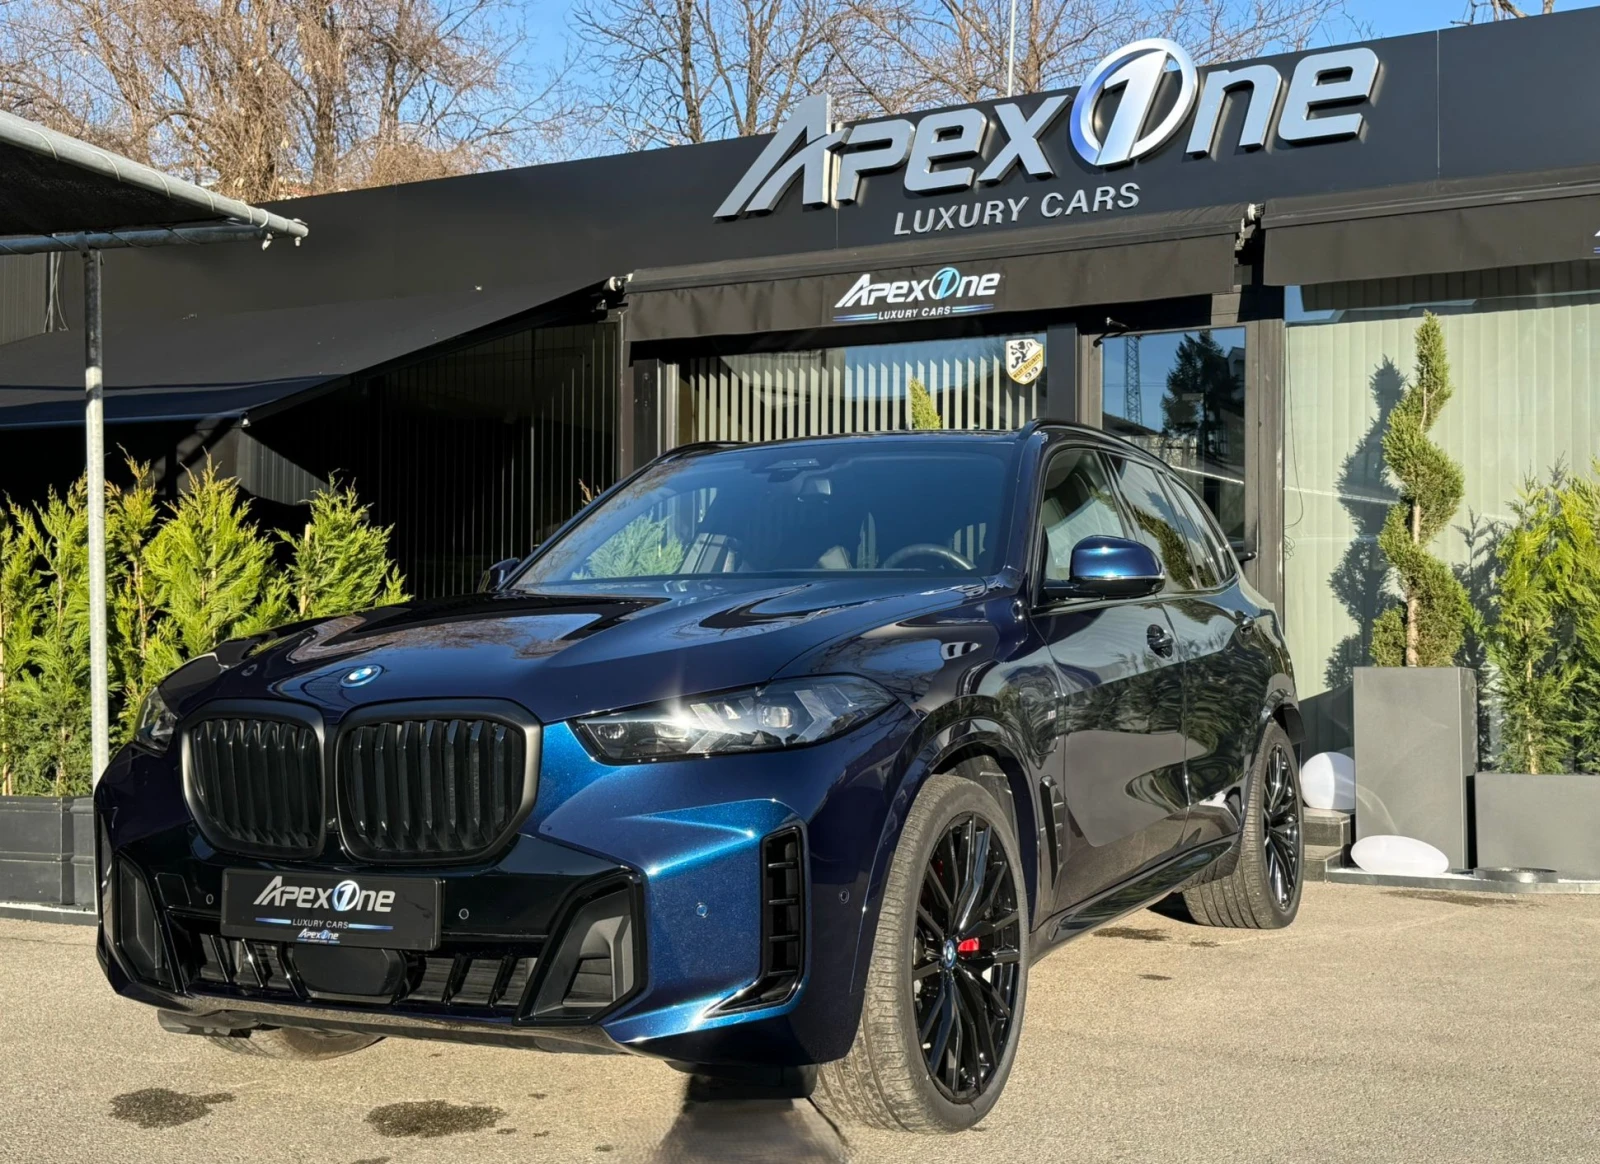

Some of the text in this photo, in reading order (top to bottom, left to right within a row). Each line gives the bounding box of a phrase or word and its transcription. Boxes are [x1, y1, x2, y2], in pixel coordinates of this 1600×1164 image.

[894, 182, 1141, 236] LUXURY CARS
[878, 306, 951, 320] LUXURY CARS
[292, 918, 349, 929] LUXURY CARS
